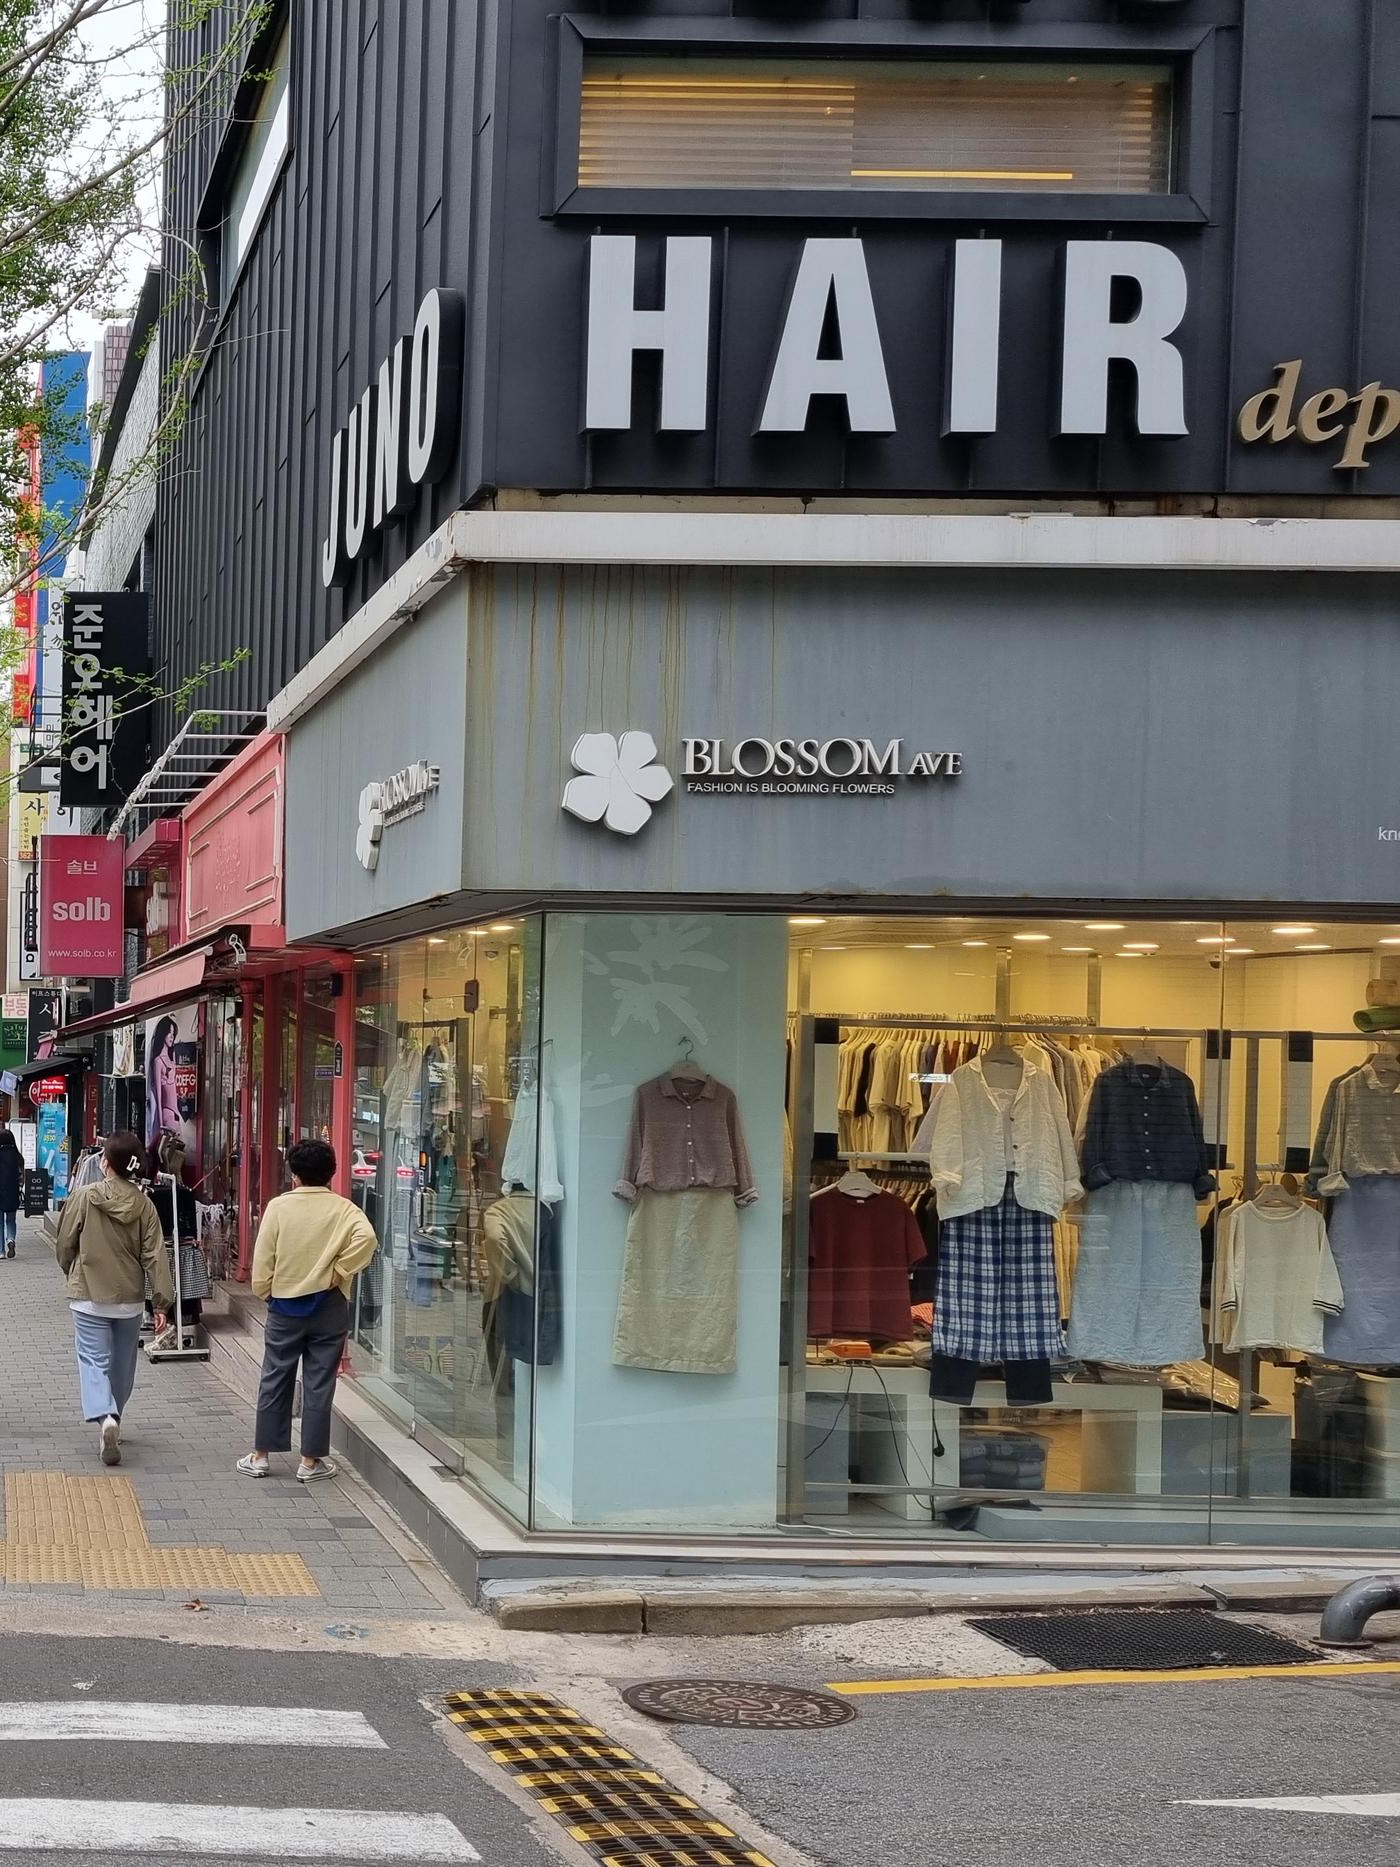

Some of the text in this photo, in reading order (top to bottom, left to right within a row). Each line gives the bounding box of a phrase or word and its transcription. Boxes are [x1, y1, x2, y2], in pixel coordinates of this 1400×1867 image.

[584, 235, 1190, 435] HAIR
[1237, 358, 1400, 471] dep
[322, 287, 462, 589] JUNO
[70, 603, 114, 789] 준오헤어
[681, 737, 963, 777] BLOSSOM AVE
[687, 782, 895, 794] FASHION IS BLOOMING FLOWERS
[1378, 826, 1400, 840] kn
[67, 860, 98, 875] 솔브
[52, 897, 111, 922] solb
[48, 949, 117, 958] www.solb.co.kr
